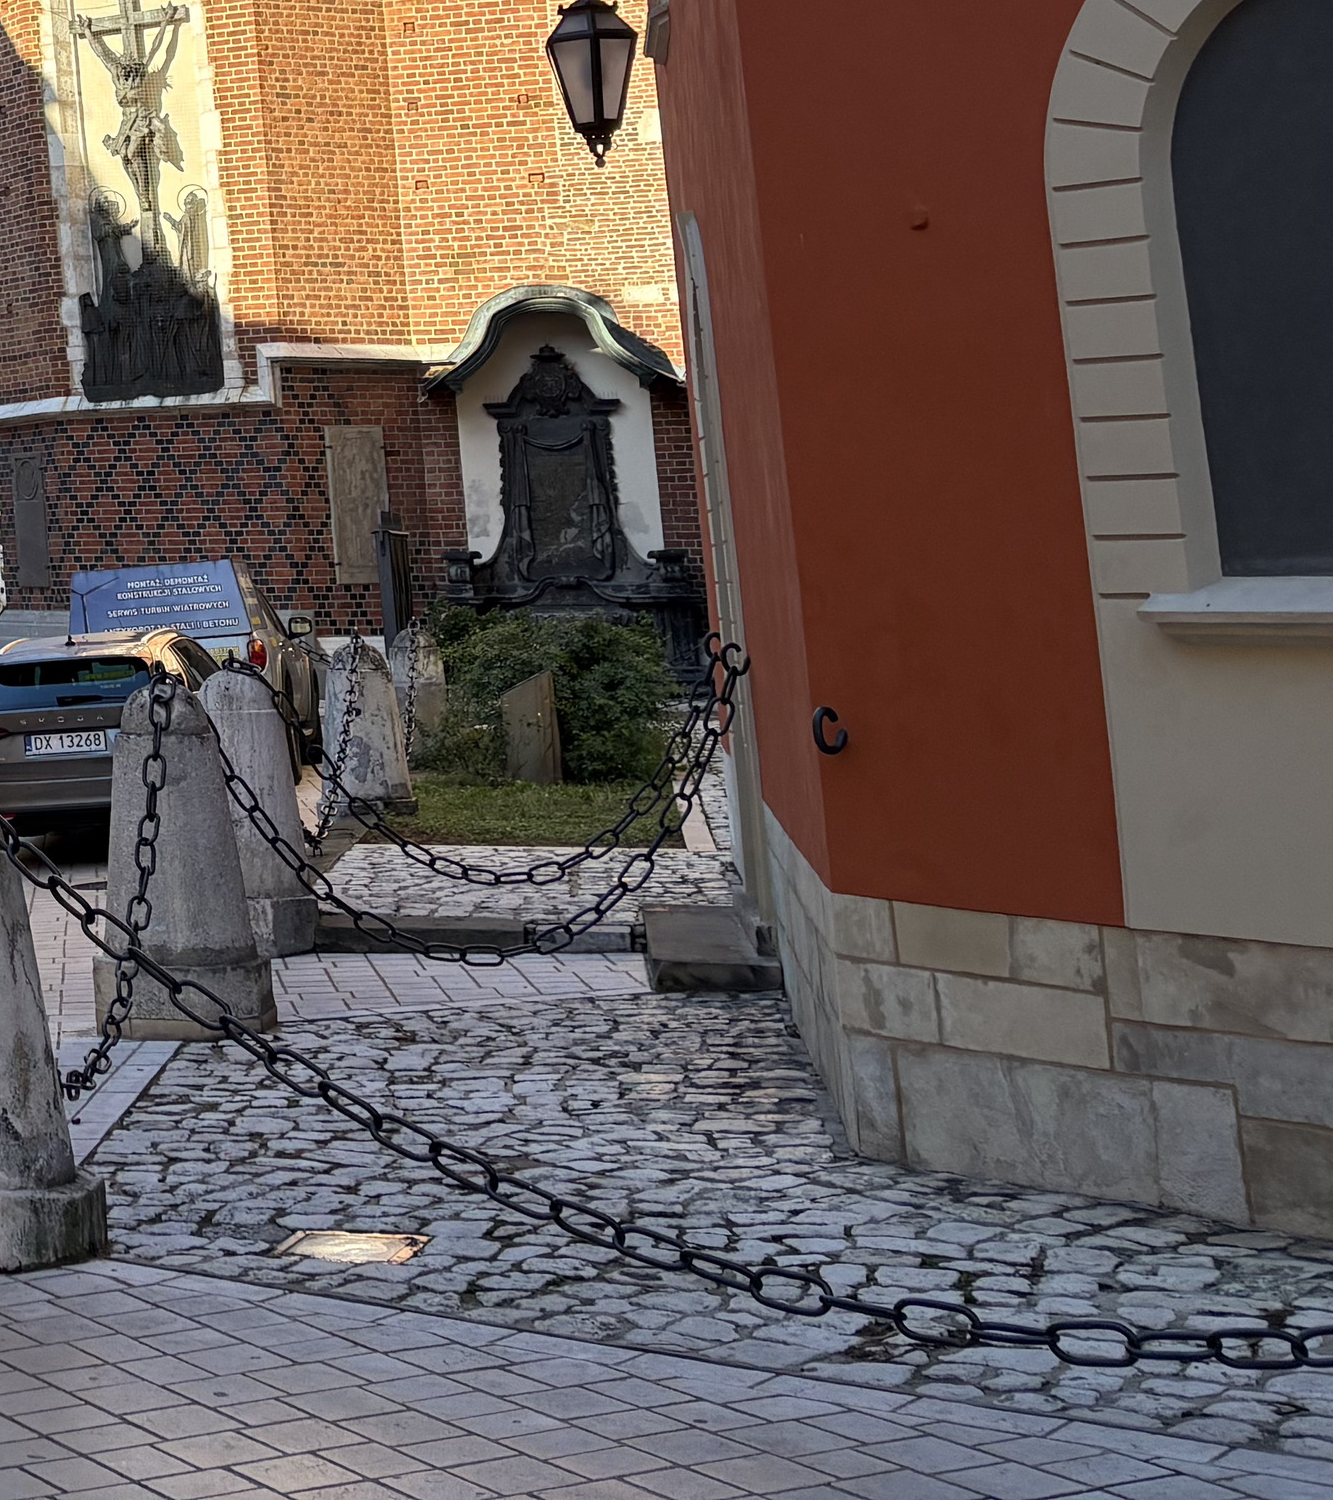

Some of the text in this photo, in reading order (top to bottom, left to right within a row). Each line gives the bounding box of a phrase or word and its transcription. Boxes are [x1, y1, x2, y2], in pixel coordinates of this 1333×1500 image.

[164, 574, 209, 586] DEMONTAŻ
[117, 585, 222, 600] KONSTRUKCJI STALOWYCH
[107, 601, 229, 618] SERWIS TURBIN WIATROWYCH
[171, 622, 194, 630] STALI
[203, 618, 239, 628] BETONU
[34, 733, 101, 750] DX 13268
